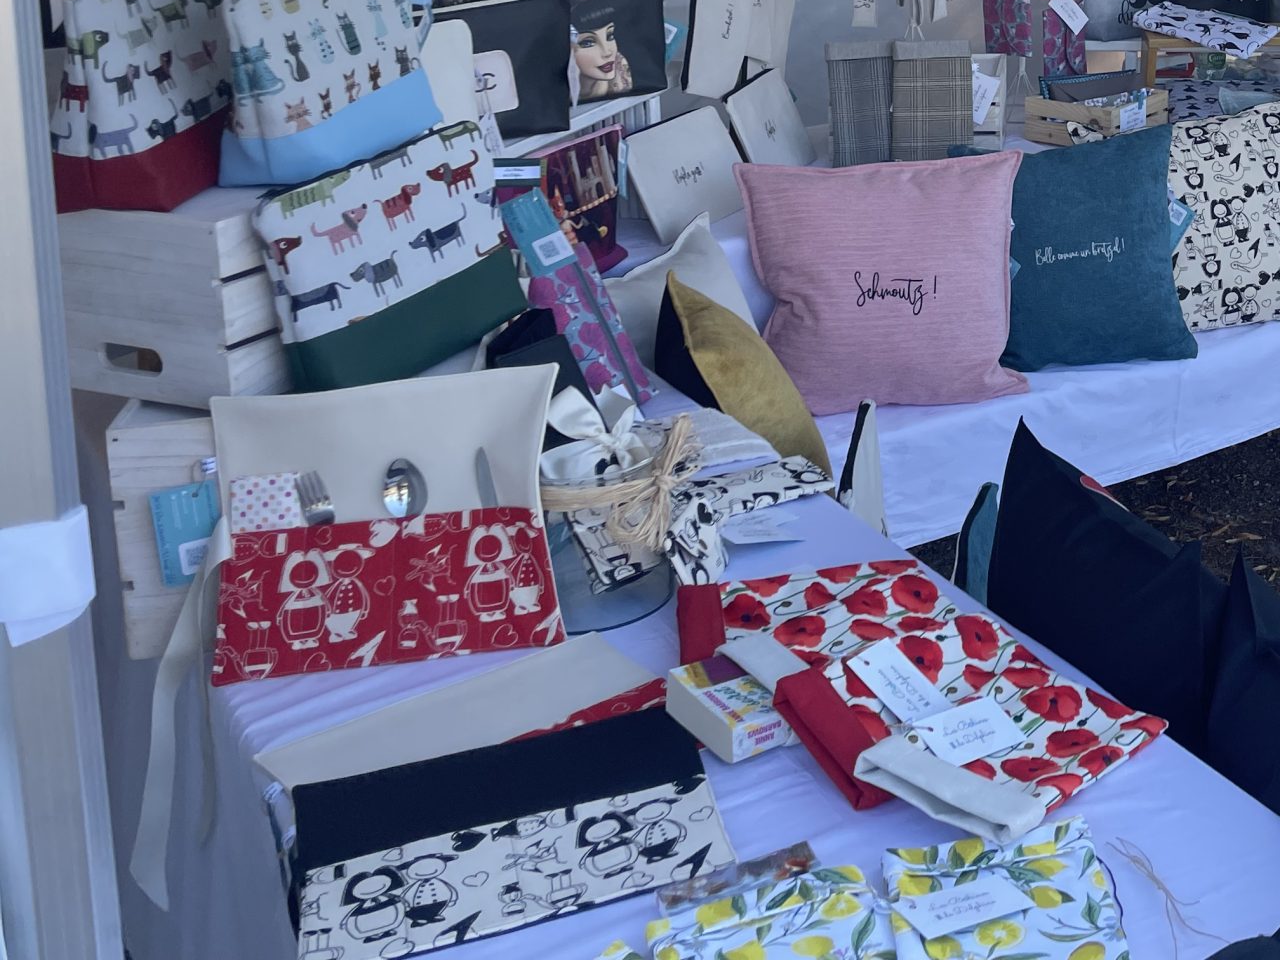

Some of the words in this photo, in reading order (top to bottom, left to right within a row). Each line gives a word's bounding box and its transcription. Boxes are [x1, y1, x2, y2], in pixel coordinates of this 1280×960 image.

[1035, 246, 1056, 266] Belle
[1057, 251, 1079, 261] comme
[1080, 248, 1091, 258] un
[854, 271, 929, 316] Schmoutz
[702, 690, 731, 712] BARROWS
[714, 686, 761, 707] secret
[728, 708, 745, 723] ANNIE
[748, 720, 782, 740] BARROWS
[755, 732, 775, 746] ANNIE
